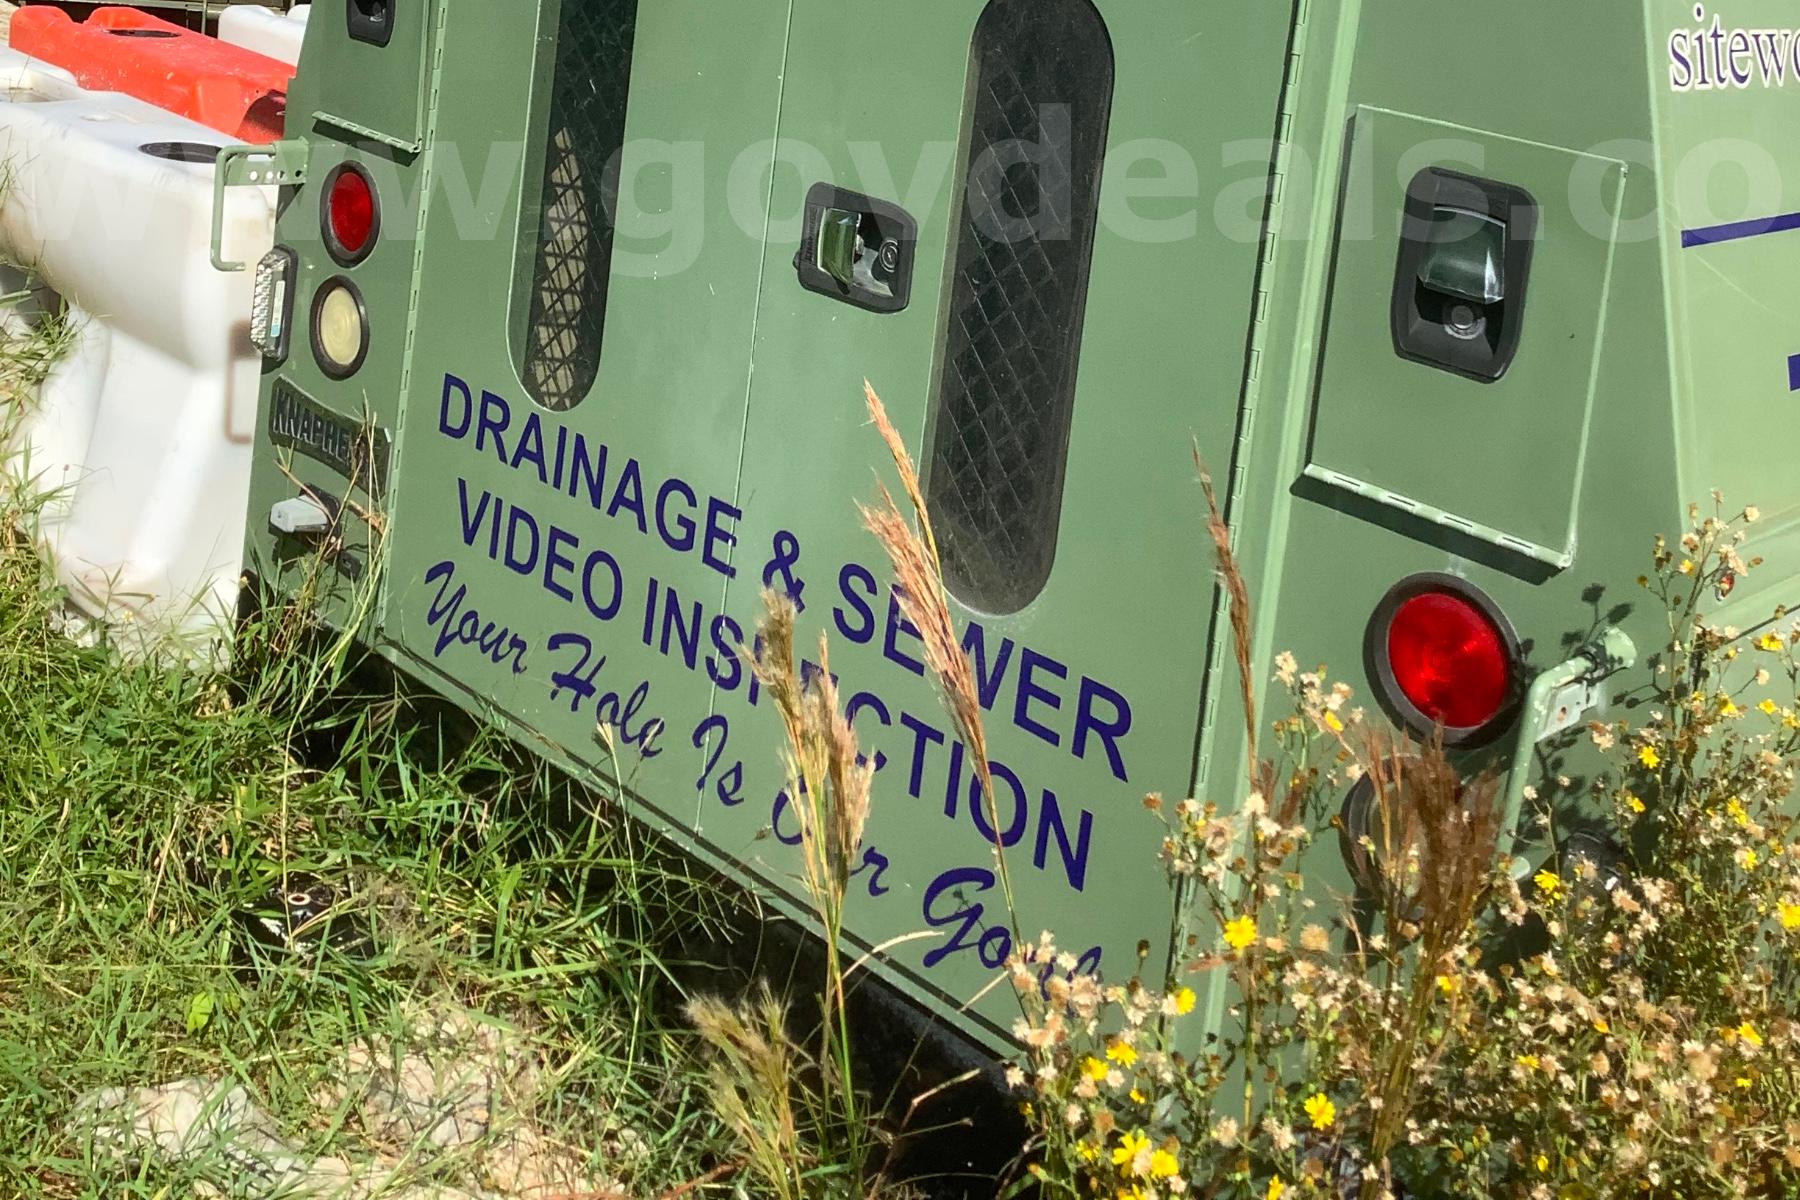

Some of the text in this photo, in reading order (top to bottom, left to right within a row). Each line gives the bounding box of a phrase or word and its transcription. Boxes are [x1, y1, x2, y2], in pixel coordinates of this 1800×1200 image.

[438, 372, 743, 580] DRAINAGE
[762, 530, 805, 613] &
[424, 561, 528, 674] Your
[547, 633, 665, 758] Hole
[692, 714, 744, 806] Is
[772, 774, 889, 897] Or
[457, 477, 1093, 891] VIDEO INSCTION
